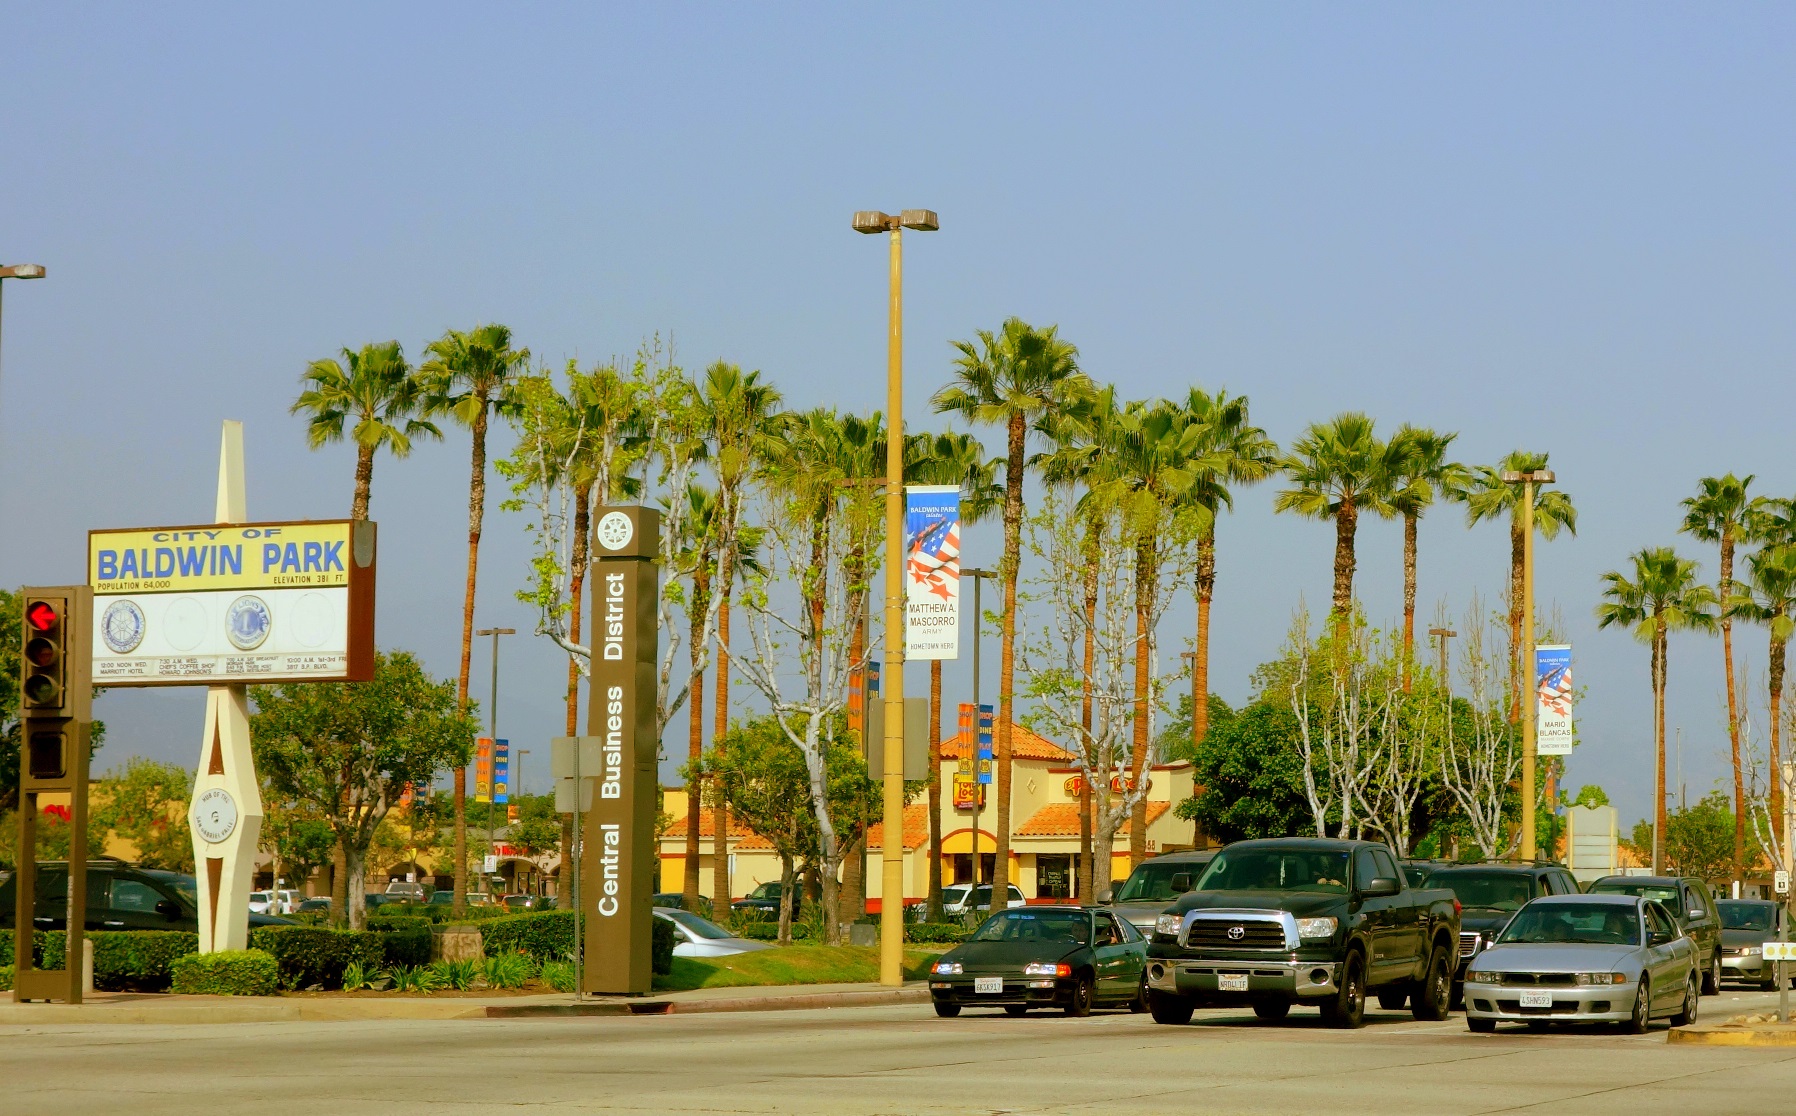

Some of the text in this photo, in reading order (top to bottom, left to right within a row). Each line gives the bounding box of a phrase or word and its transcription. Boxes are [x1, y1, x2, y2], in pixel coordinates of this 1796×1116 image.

[153, 529, 281, 542] CITY OF
[98, 541, 345, 580] BALDWIN PARK
[98, 580, 171, 590] POPULATION 64,000
[274, 575, 311, 584] ELEVATION
[909, 603, 957, 613] MATTHEW A.
[604, 573, 624, 660] District
[910, 616, 955, 626] MASCORRO
[601, 686, 623, 799] Business
[202, 792, 212, 803] HUB
[200, 827, 221, 839] GABRIEL
[598, 824, 620, 917] Central
[1521, 996, 1551, 1005] 4SHN593
